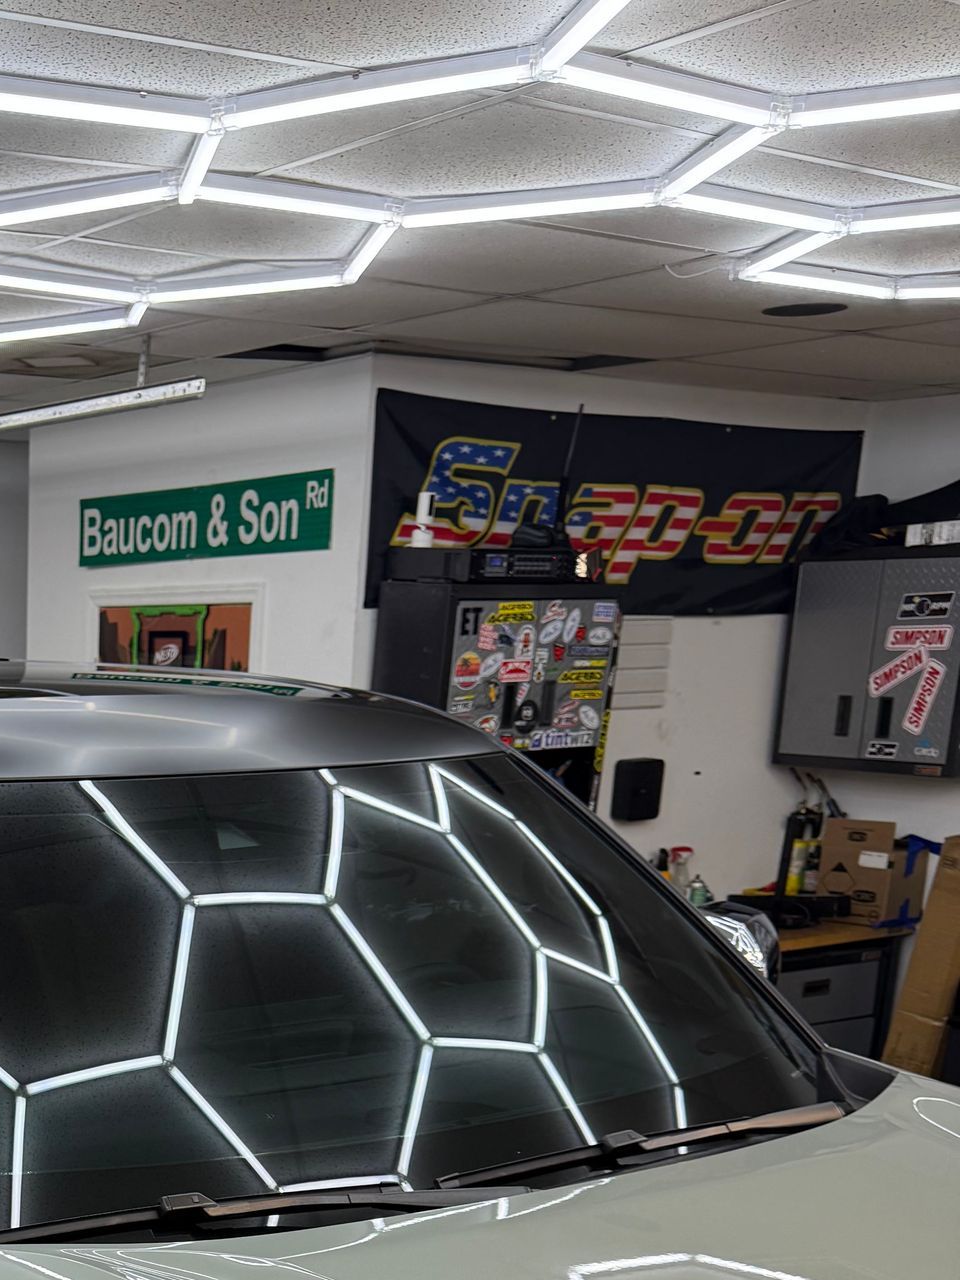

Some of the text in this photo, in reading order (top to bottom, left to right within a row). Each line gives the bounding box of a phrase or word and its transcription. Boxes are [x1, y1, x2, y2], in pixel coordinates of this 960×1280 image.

[82, 479, 330, 556] Baucom & Son Rd
[389, 436, 840, 584] Snap-on
[460, 607, 483, 636] ET
[891, 629, 948, 646] SIMPSON
[872, 649, 922, 691] SIMPSON
[908, 666, 941, 728] SIMPSON
[544, 731, 593, 747] tintwiz
